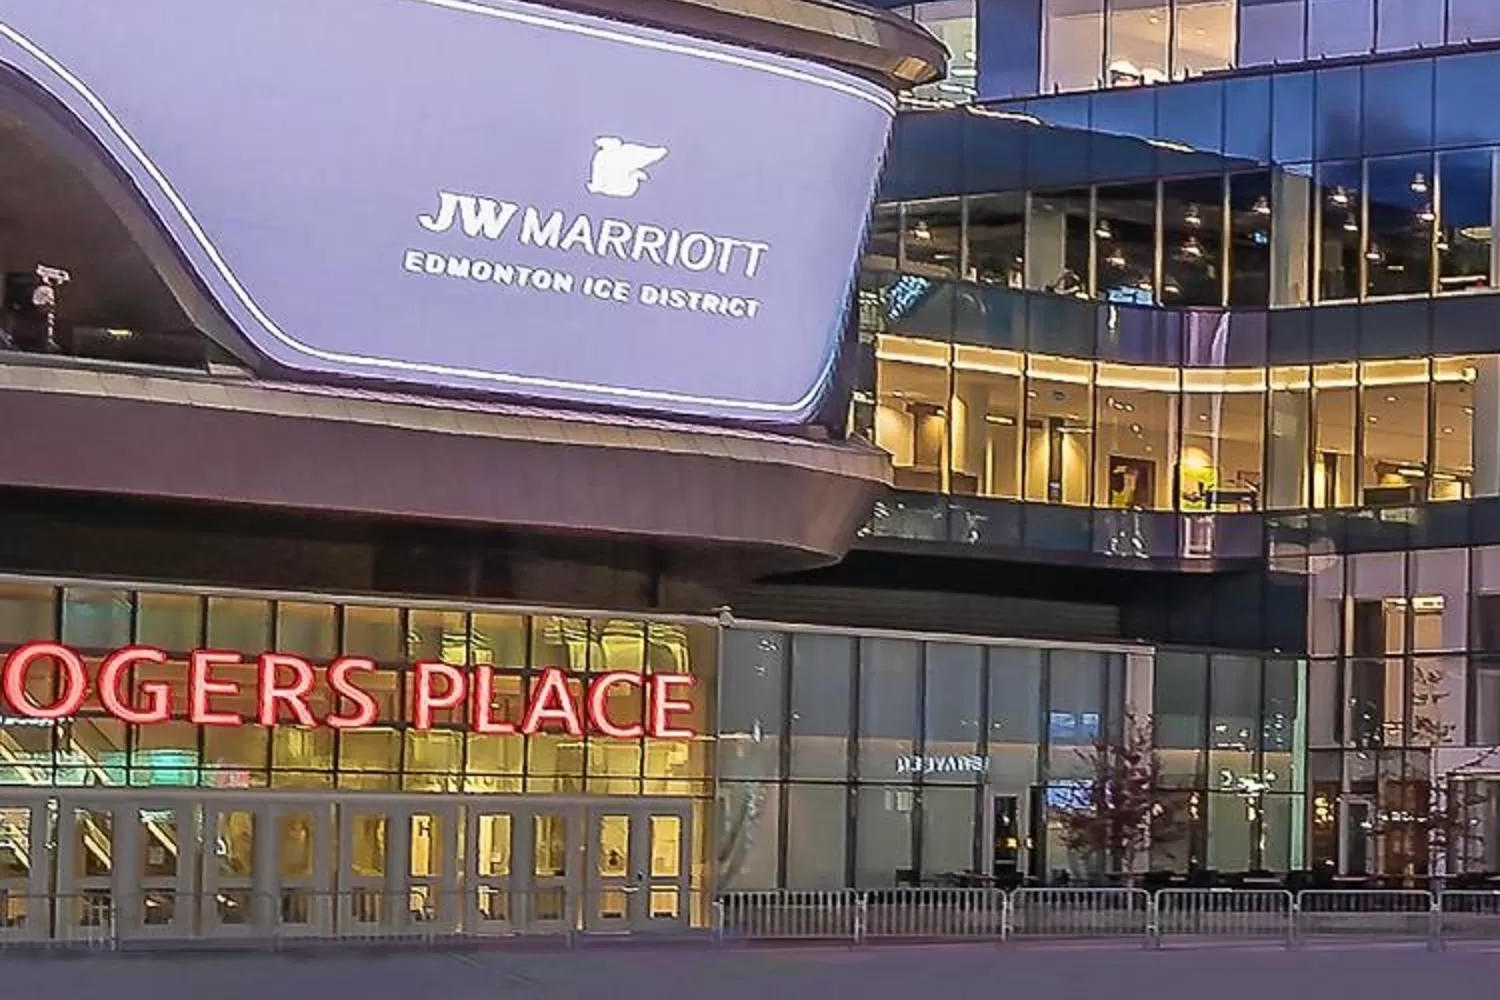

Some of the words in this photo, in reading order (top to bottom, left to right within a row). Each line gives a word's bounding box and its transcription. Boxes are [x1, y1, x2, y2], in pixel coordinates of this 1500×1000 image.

[418, 191, 518, 240] JW
[521, 207, 769, 278] MARRIOTT
[404, 250, 574, 294] EDMONTON
[583, 276, 632, 302] ICE
[640, 284, 760, 318] DISTRICT
[3, 639, 380, 728] OGERS
[410, 659, 697, 741] PLACE
